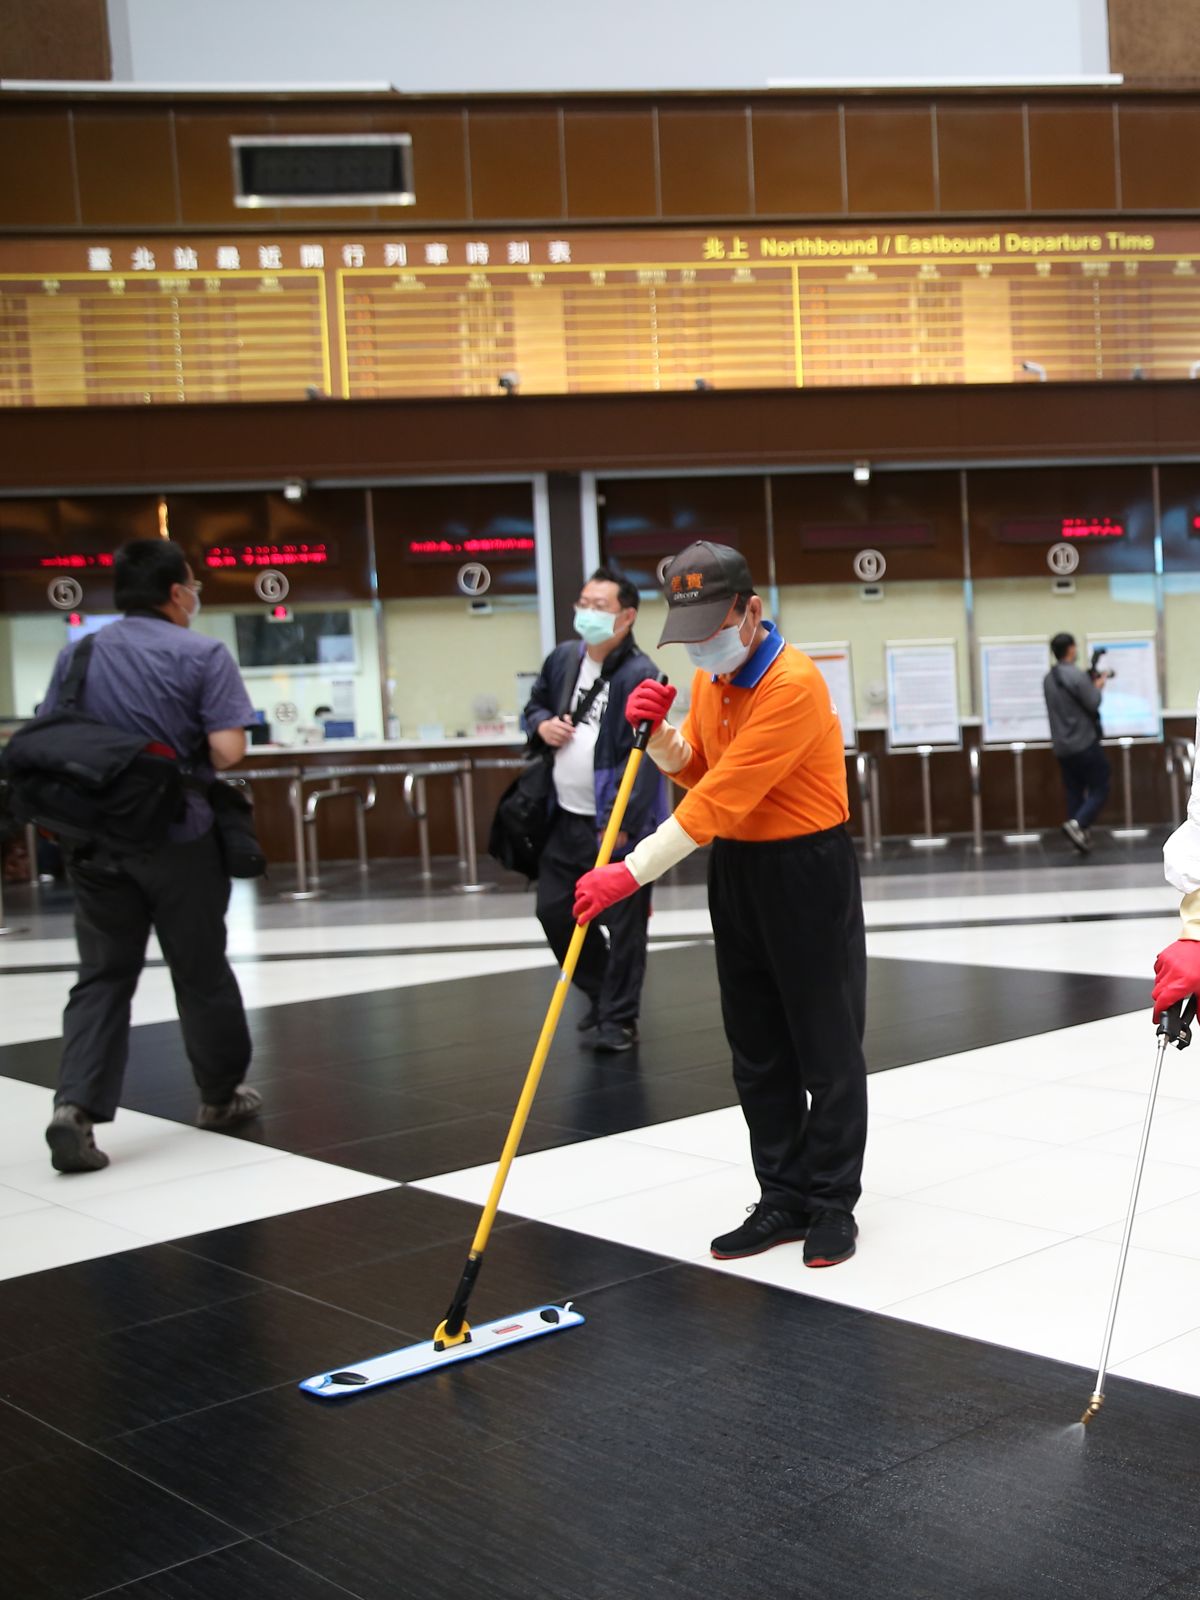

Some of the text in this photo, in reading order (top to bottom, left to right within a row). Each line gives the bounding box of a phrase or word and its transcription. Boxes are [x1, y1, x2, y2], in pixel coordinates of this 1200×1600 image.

[760, 235, 879, 257] Northbound
[894, 233, 1001, 254] Eastbound
[1004, 232, 1103, 255] Departure
[1105, 231, 1155, 250] Time
